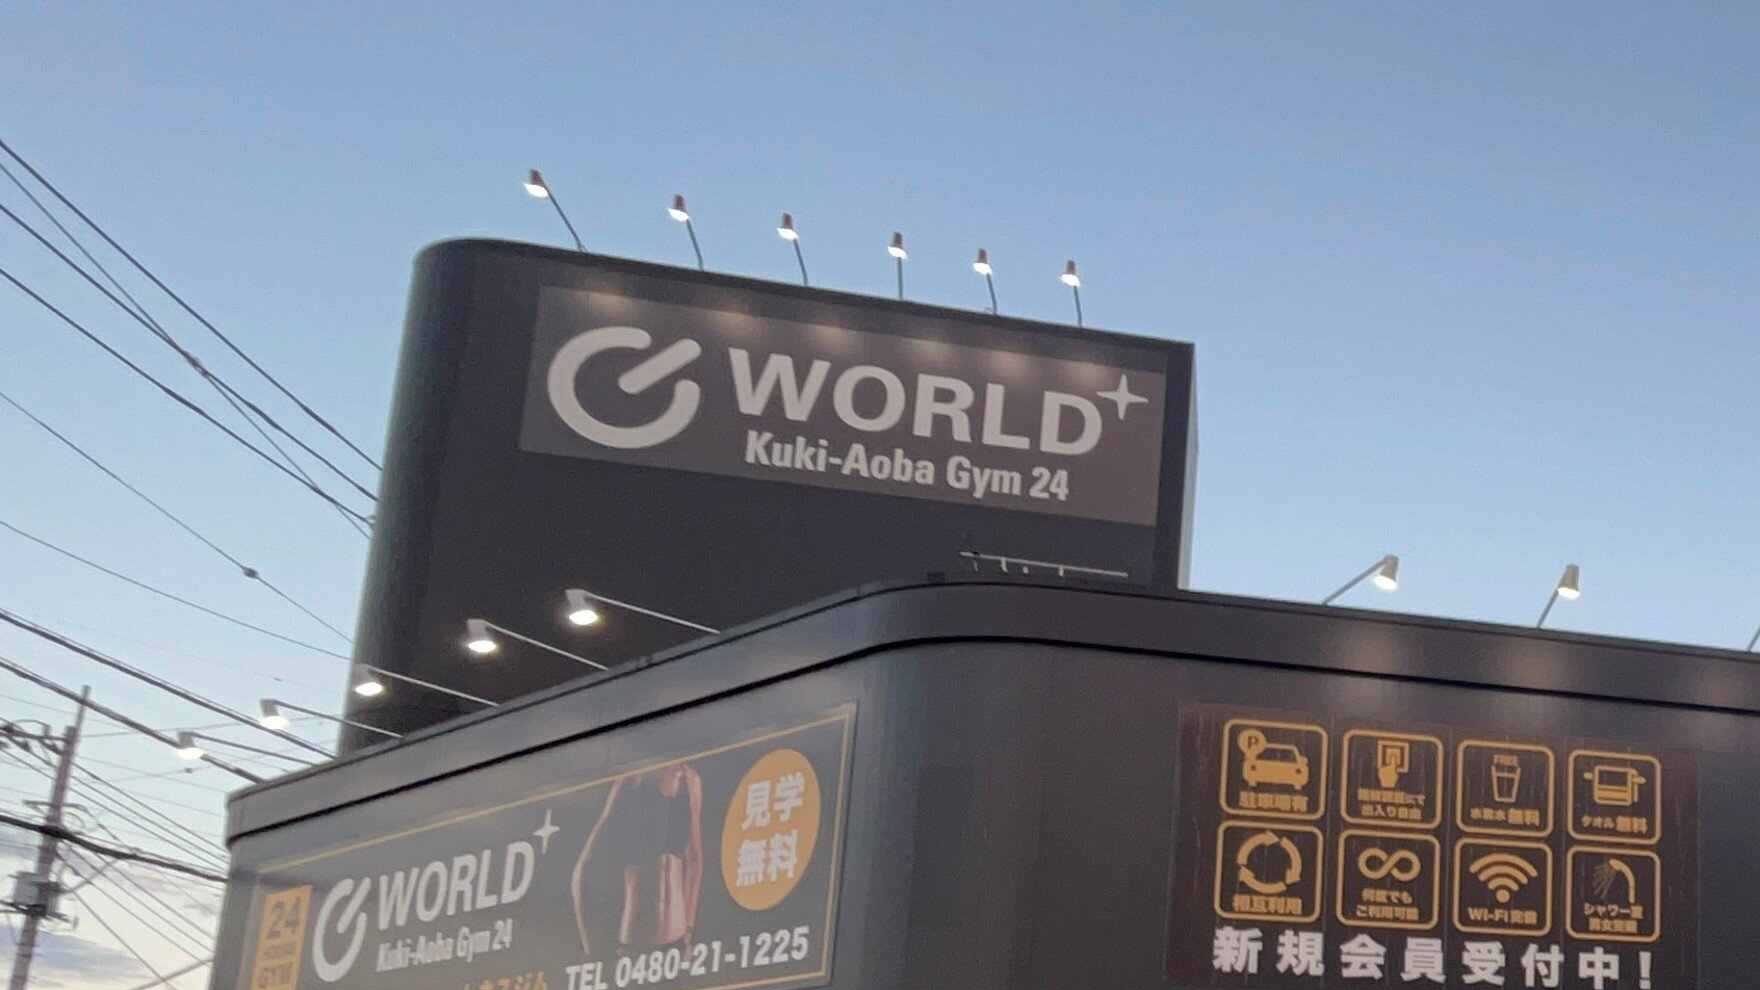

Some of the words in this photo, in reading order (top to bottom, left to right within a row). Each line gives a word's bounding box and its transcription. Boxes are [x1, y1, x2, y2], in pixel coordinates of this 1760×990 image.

[744, 430, 935, 486] Kuki-Aoba
[946, 455, 1021, 499] Gym
[1029, 465, 1070, 501] 24
[741, 772, 806, 829] 見学
[735, 830, 800, 888] 無料
[456, 926, 491, 963] Gym
[492, 918, 513, 950] 24
[614, 926, 810, 989] 0480-21-1225
